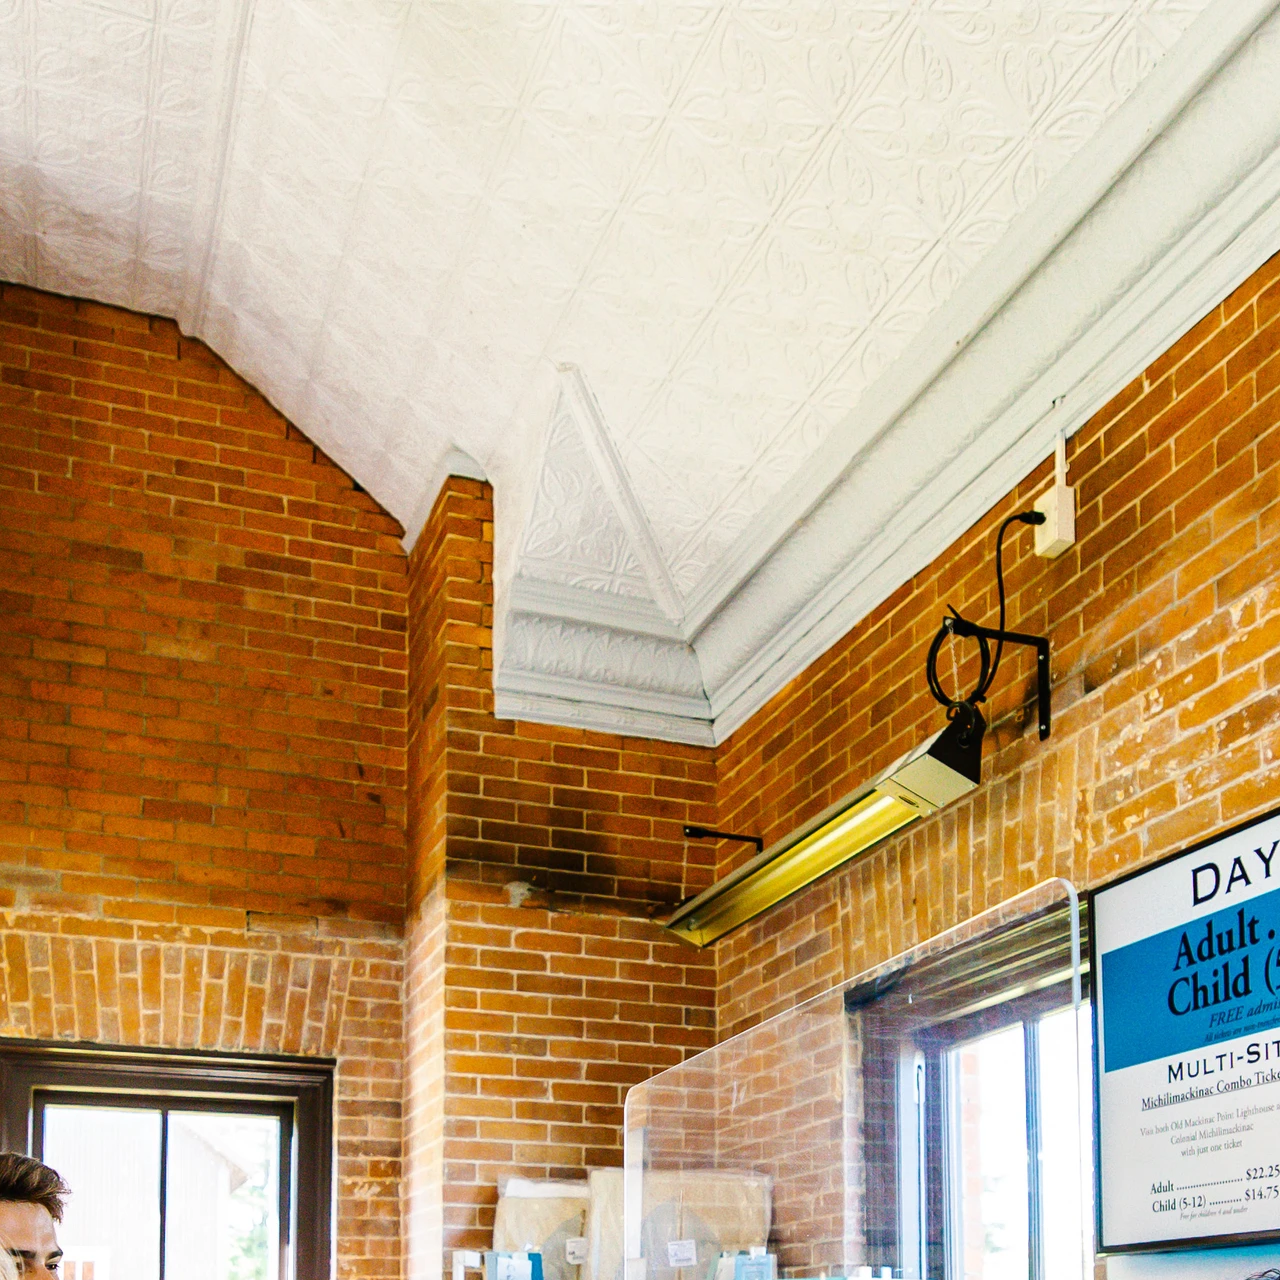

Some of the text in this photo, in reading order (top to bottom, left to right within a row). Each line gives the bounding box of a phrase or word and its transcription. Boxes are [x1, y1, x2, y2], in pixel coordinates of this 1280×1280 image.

[1191, 839, 1280, 907] DAY
[1171, 907, 1261, 971] Adult
[1167, 957, 1253, 1018] Child
[1208, 1004, 1244, 1029] FREE
[1141, 1084, 1215, 1112] Michilimackinac
[1216, 1076, 1253, 1095] Combo
[1170, 1119, 1184, 1132] Old
[1184, 1114, 1216, 1130] Mackinac
[1236, 1103, 1275, 1121] Lighthouse
[1170, 1123, 1254, 1145] Colonial Michilimackinac
[1181, 1147, 1196, 1157] with
[1210, 1143, 1223, 1152] one
[1224, 1138, 1243, 1150] ticket
[1150, 1180, 1175, 1196] Adult
[1152, 1184, 1280, 1214] Child (5-12) $14.75
